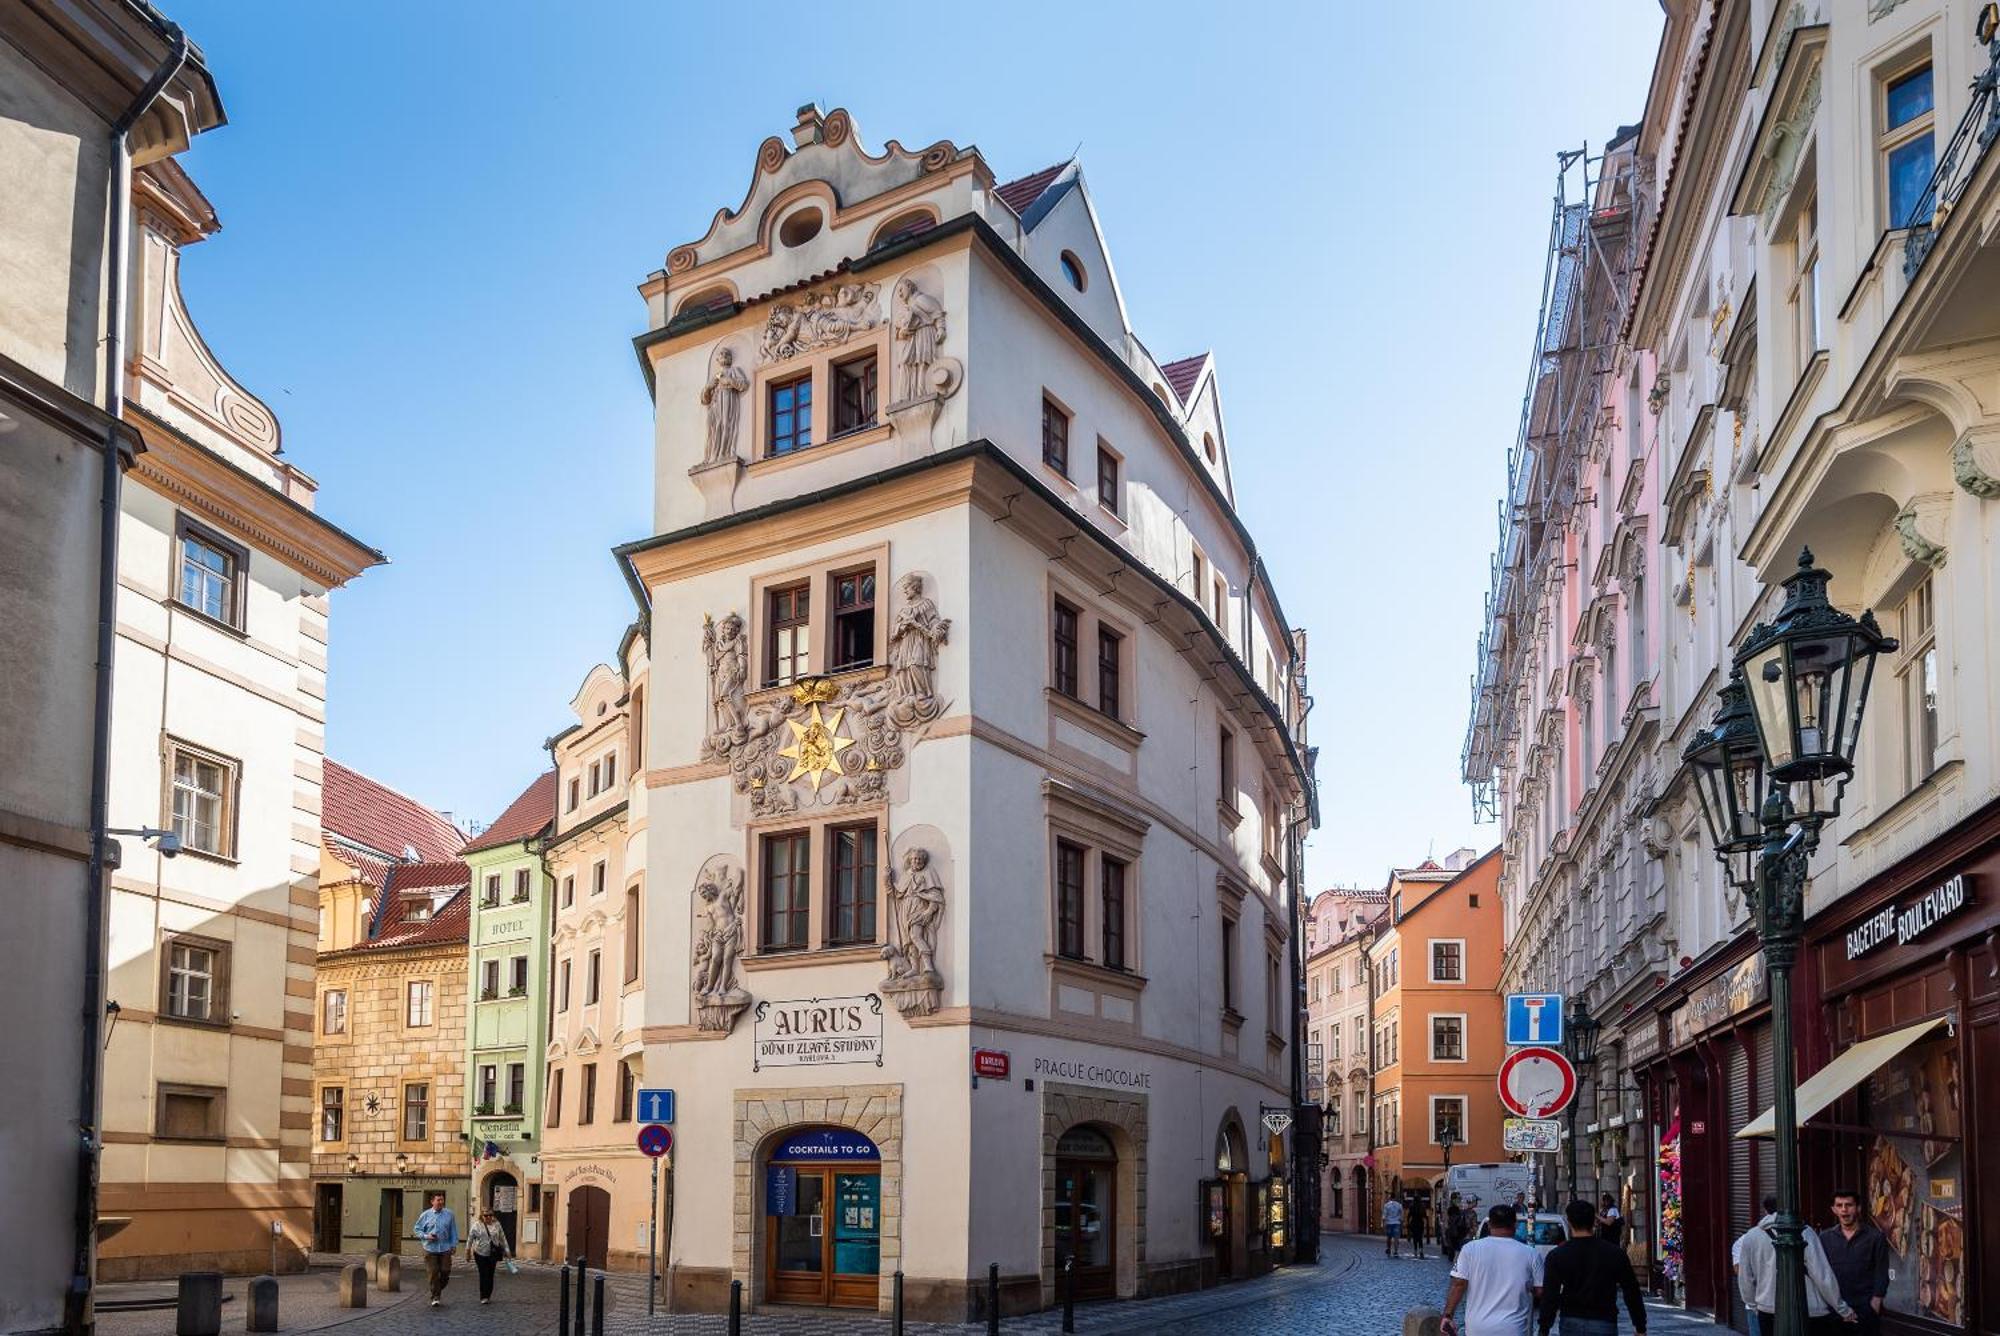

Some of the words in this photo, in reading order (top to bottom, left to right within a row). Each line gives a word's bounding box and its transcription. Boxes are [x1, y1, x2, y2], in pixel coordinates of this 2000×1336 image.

[492, 920, 524, 935] HOTEL
[1846, 904, 1896, 961] BAGETERIE
[1897, 874, 1964, 946] BOULEVARD
[774, 1006, 862, 1035] AURUS
[761, 1041, 785, 1056] DŮM
[787, 1043, 794, 1054] U
[1034, 1058, 1085, 1080] PRAGUE
[1087, 1065, 1151, 1089] CHOCOLATE
[788, 1146, 838, 1154] COCKTAILS
[841, 1146, 854, 1154] TO
